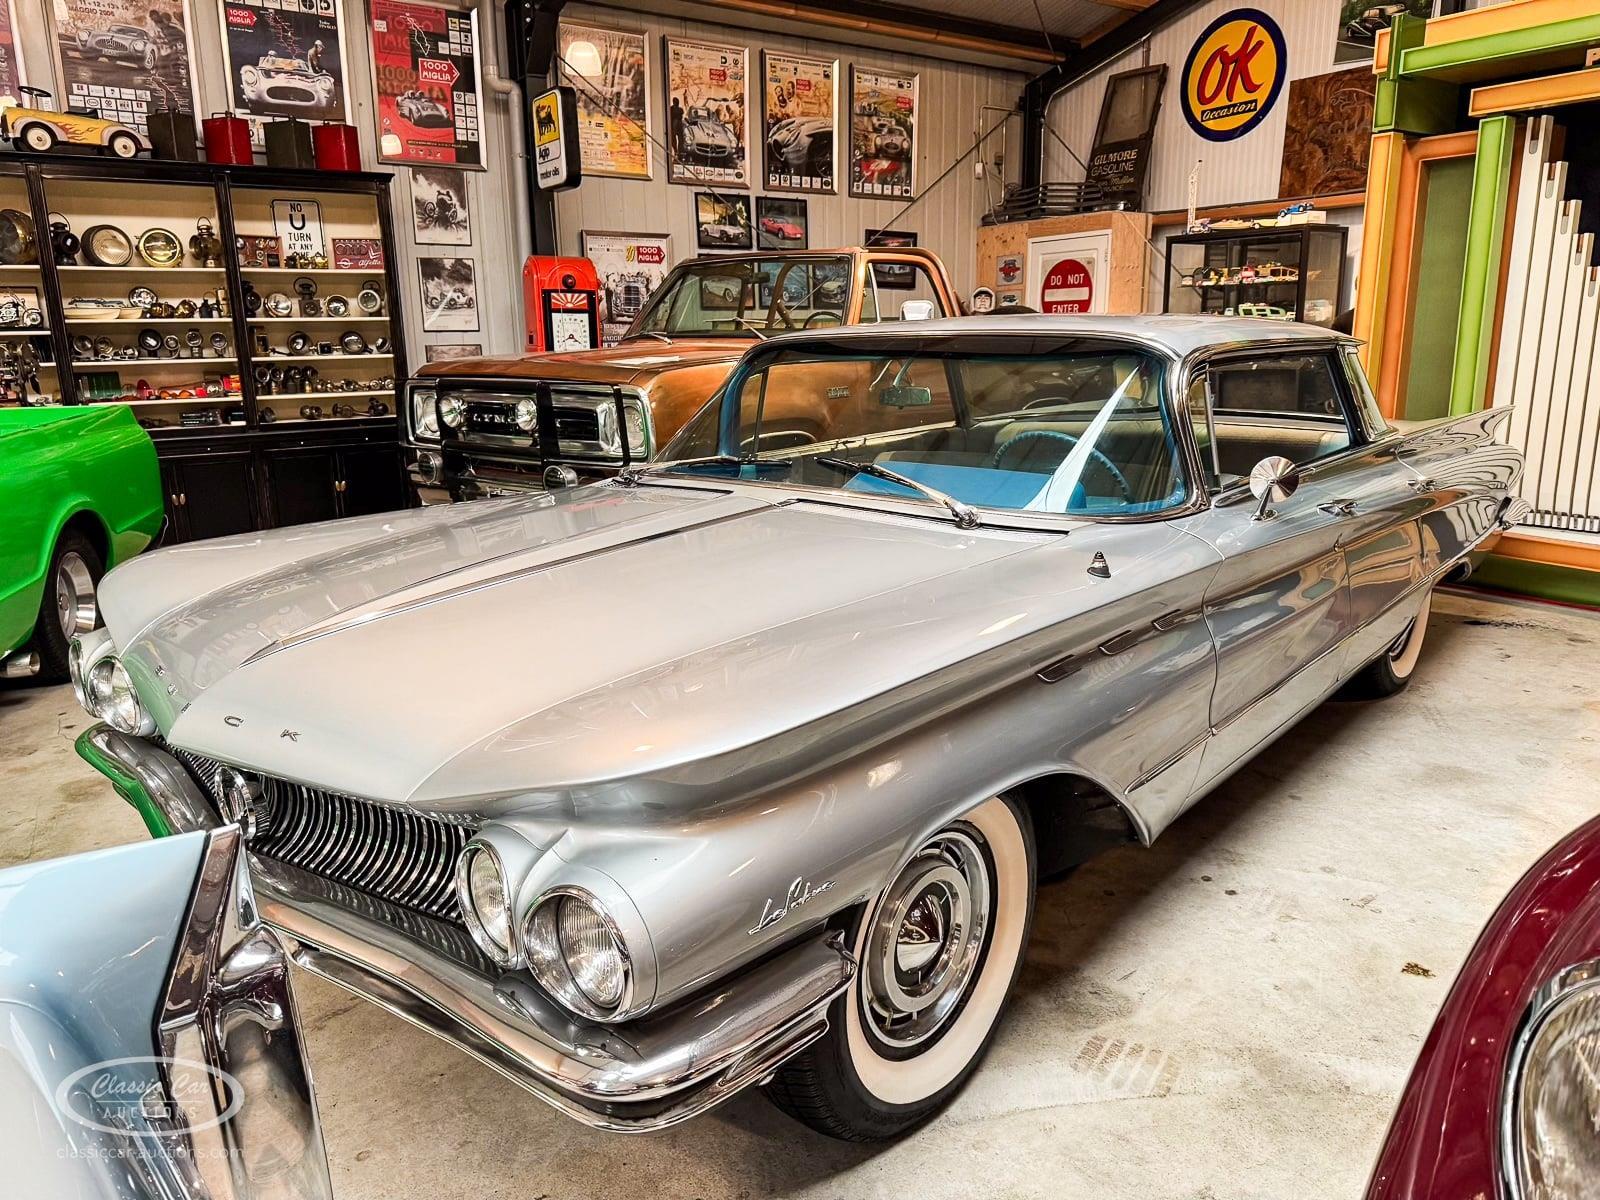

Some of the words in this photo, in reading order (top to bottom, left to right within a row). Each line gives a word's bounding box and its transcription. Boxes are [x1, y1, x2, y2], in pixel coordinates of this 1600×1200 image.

[229, 9, 249, 17] 1000
[228, 16, 252, 24] MIGLIA
[423, 61, 449, 71] 1000
[1197, 25, 1264, 105] OK
[422, 70, 451, 81] MIGLIA
[1202, 101, 1257, 121] Occasion
[1094, 148, 1138, 166] GILMORE
[1091, 160, 1135, 177] GASOLINE
[289, 202, 303, 212] NO
[288, 213, 306, 230] U
[287, 232, 312, 242] TURN
[300, 243, 313, 251] ANY
[638, 253, 660, 261] MIGLIA
[1050, 275, 1063, 286] DO
[1067, 273, 1085, 285] NOT
[1051, 303, 1080, 313] ENTER
